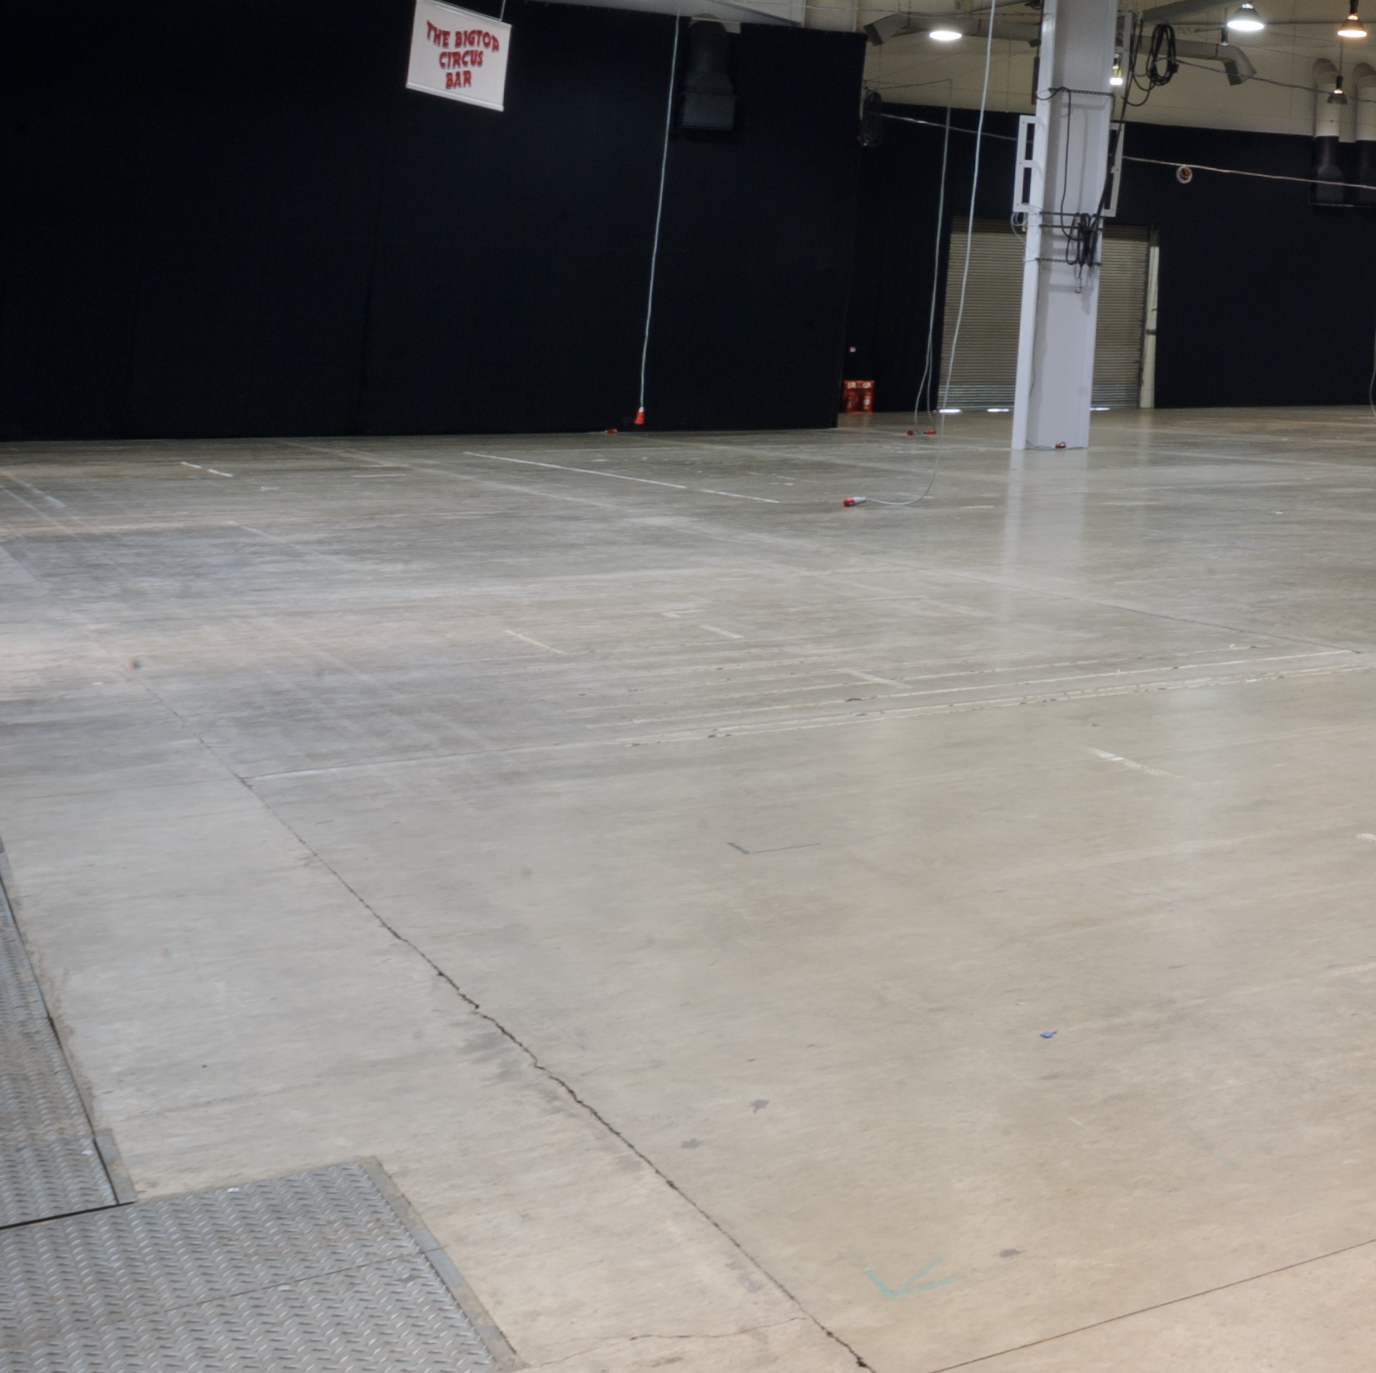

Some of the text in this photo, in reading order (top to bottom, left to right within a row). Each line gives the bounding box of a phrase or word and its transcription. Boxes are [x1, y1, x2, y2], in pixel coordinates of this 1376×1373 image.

[426, 20, 451, 49] THE
[439, 50, 484, 69] CIRCUS
[445, 70, 472, 89] BAR
